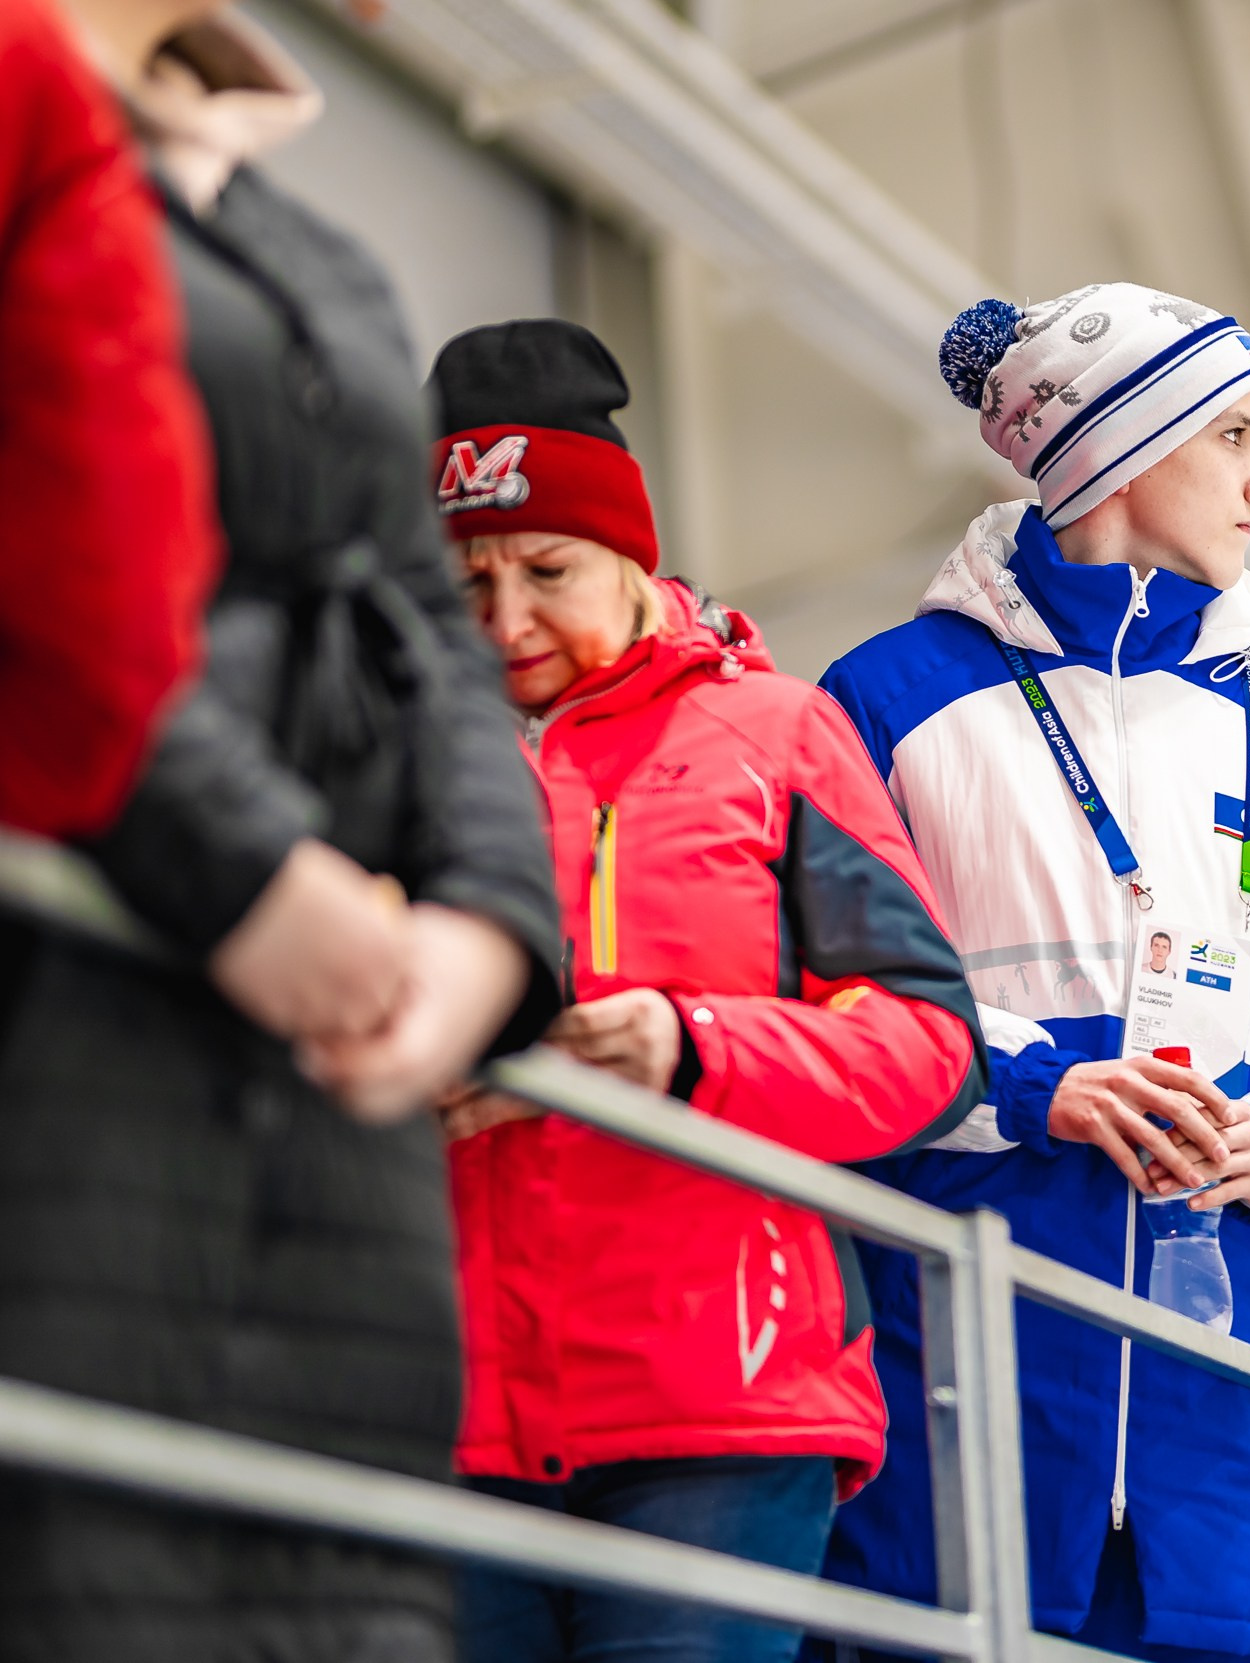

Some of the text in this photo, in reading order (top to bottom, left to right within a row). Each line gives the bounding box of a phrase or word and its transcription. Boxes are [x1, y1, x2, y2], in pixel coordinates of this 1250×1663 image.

[1021, 677, 1047, 709] 2023
[1041, 711, 1062, 736] Asia
[1060, 745, 1090, 794] Children
[1211, 951, 1236, 964] 2023
[1200, 976, 1217, 985] ATH
[1139, 986, 1173, 999] VLADIMIR
[1137, 995, 1173, 1008] GLUKHOV
